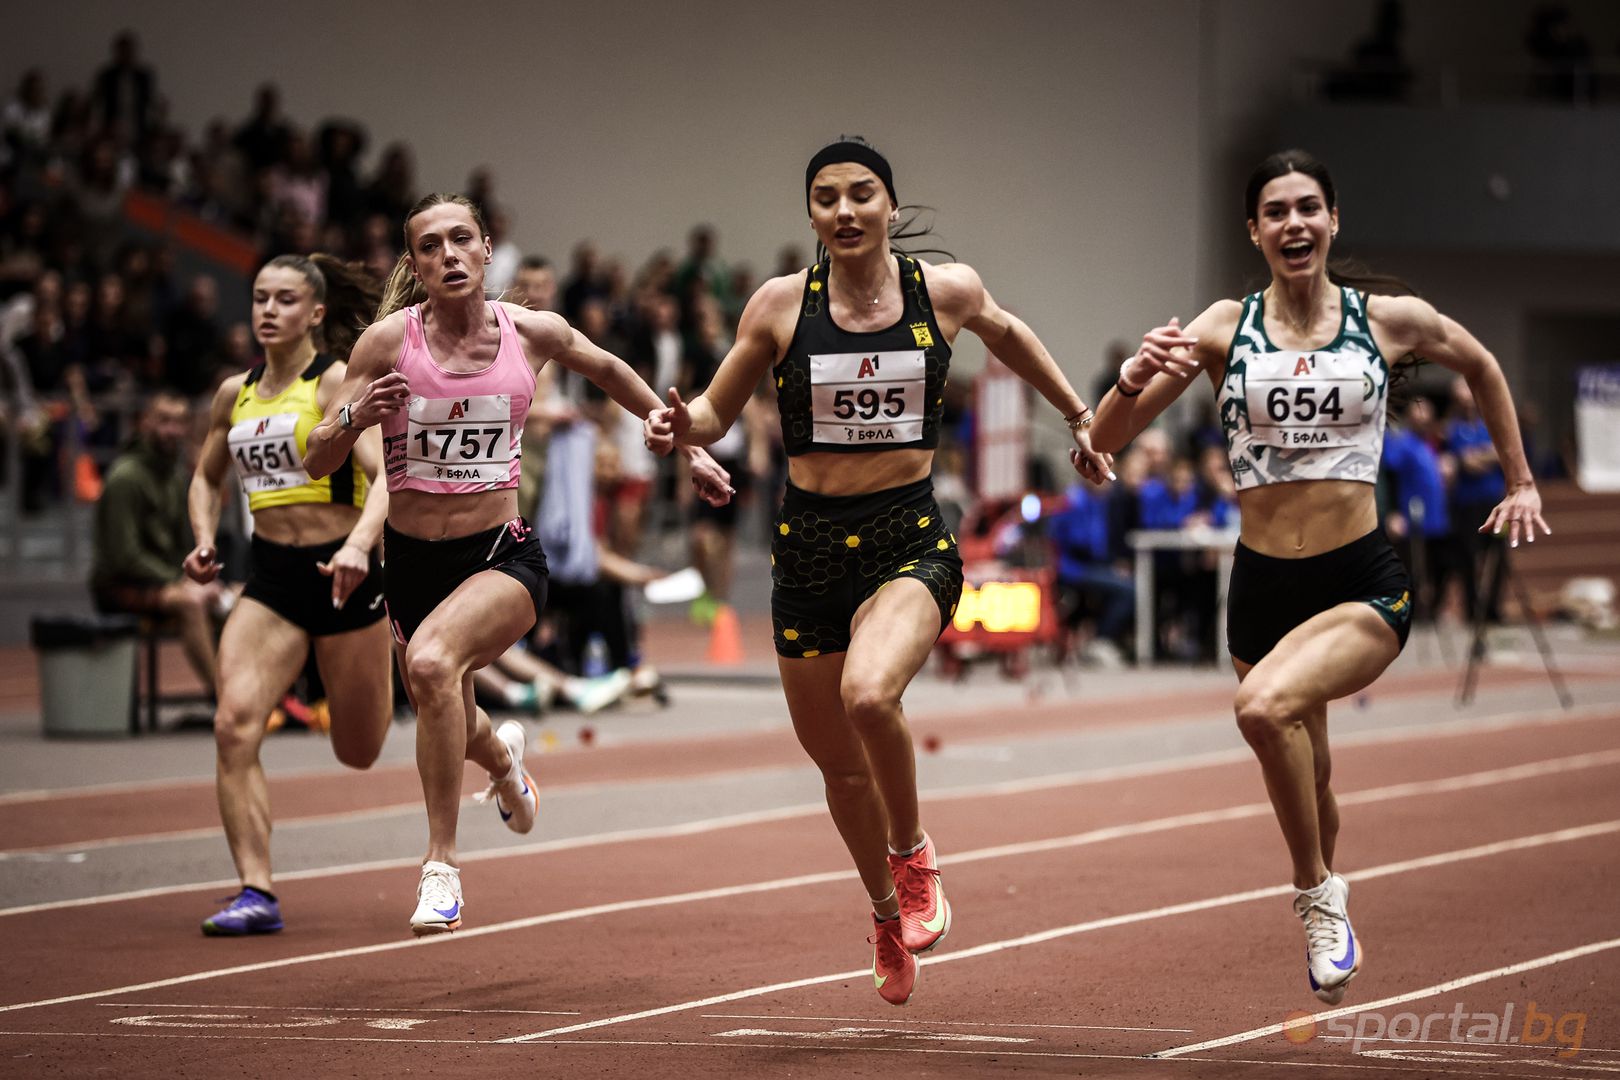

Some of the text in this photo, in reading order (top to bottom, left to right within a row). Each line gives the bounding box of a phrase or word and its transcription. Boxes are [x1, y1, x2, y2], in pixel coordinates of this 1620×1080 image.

[857, 354, 880, 379] A1
[1292, 354, 1316, 377] A1
[447, 398, 470, 420] A1
[833, 387, 905, 420] 595
[1266, 386, 1344, 422] 654
[414, 427, 504, 460] 1757
[858, 429, 895, 441] БФЛА
[1292, 432, 1329, 444] БФЛА
[236, 441, 295, 473] 1551
[446, 469, 481, 479] БФЛА
